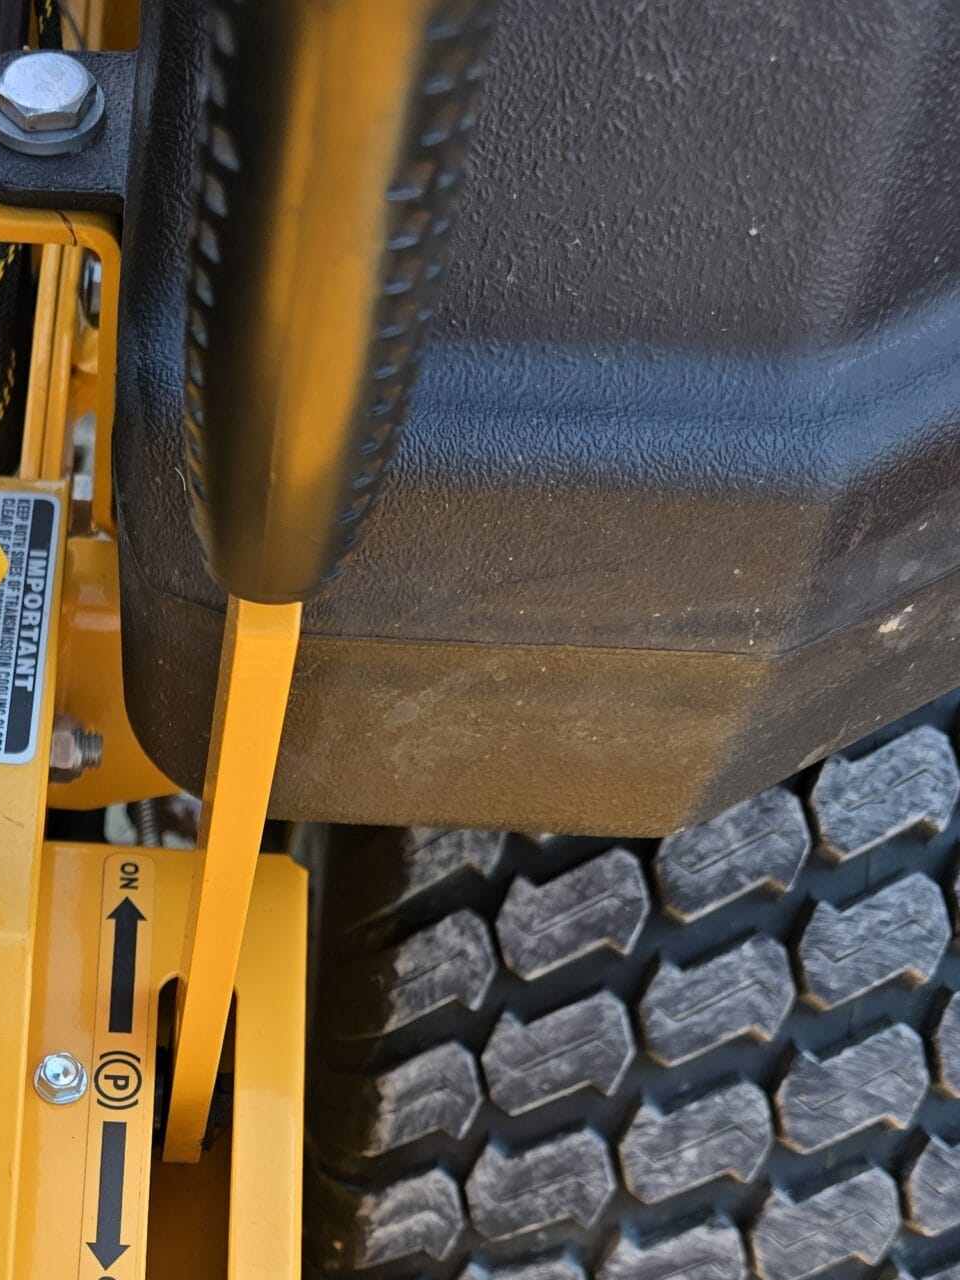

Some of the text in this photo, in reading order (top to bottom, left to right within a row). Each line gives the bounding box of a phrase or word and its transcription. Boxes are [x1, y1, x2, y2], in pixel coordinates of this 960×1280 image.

[0, 498, 16, 526] CLEAR
[16, 499, 31, 521] KEEP
[0, 530, 12, 541] OF
[13, 524, 28, 548] BOTH
[9, 551, 24, 577] SIDES
[8, 581, 21, 592] OF
[15, 550, 48, 692] IMPORTANT
[120, 863, 139, 890] ON
[104, 1074, 129, 1091] P
